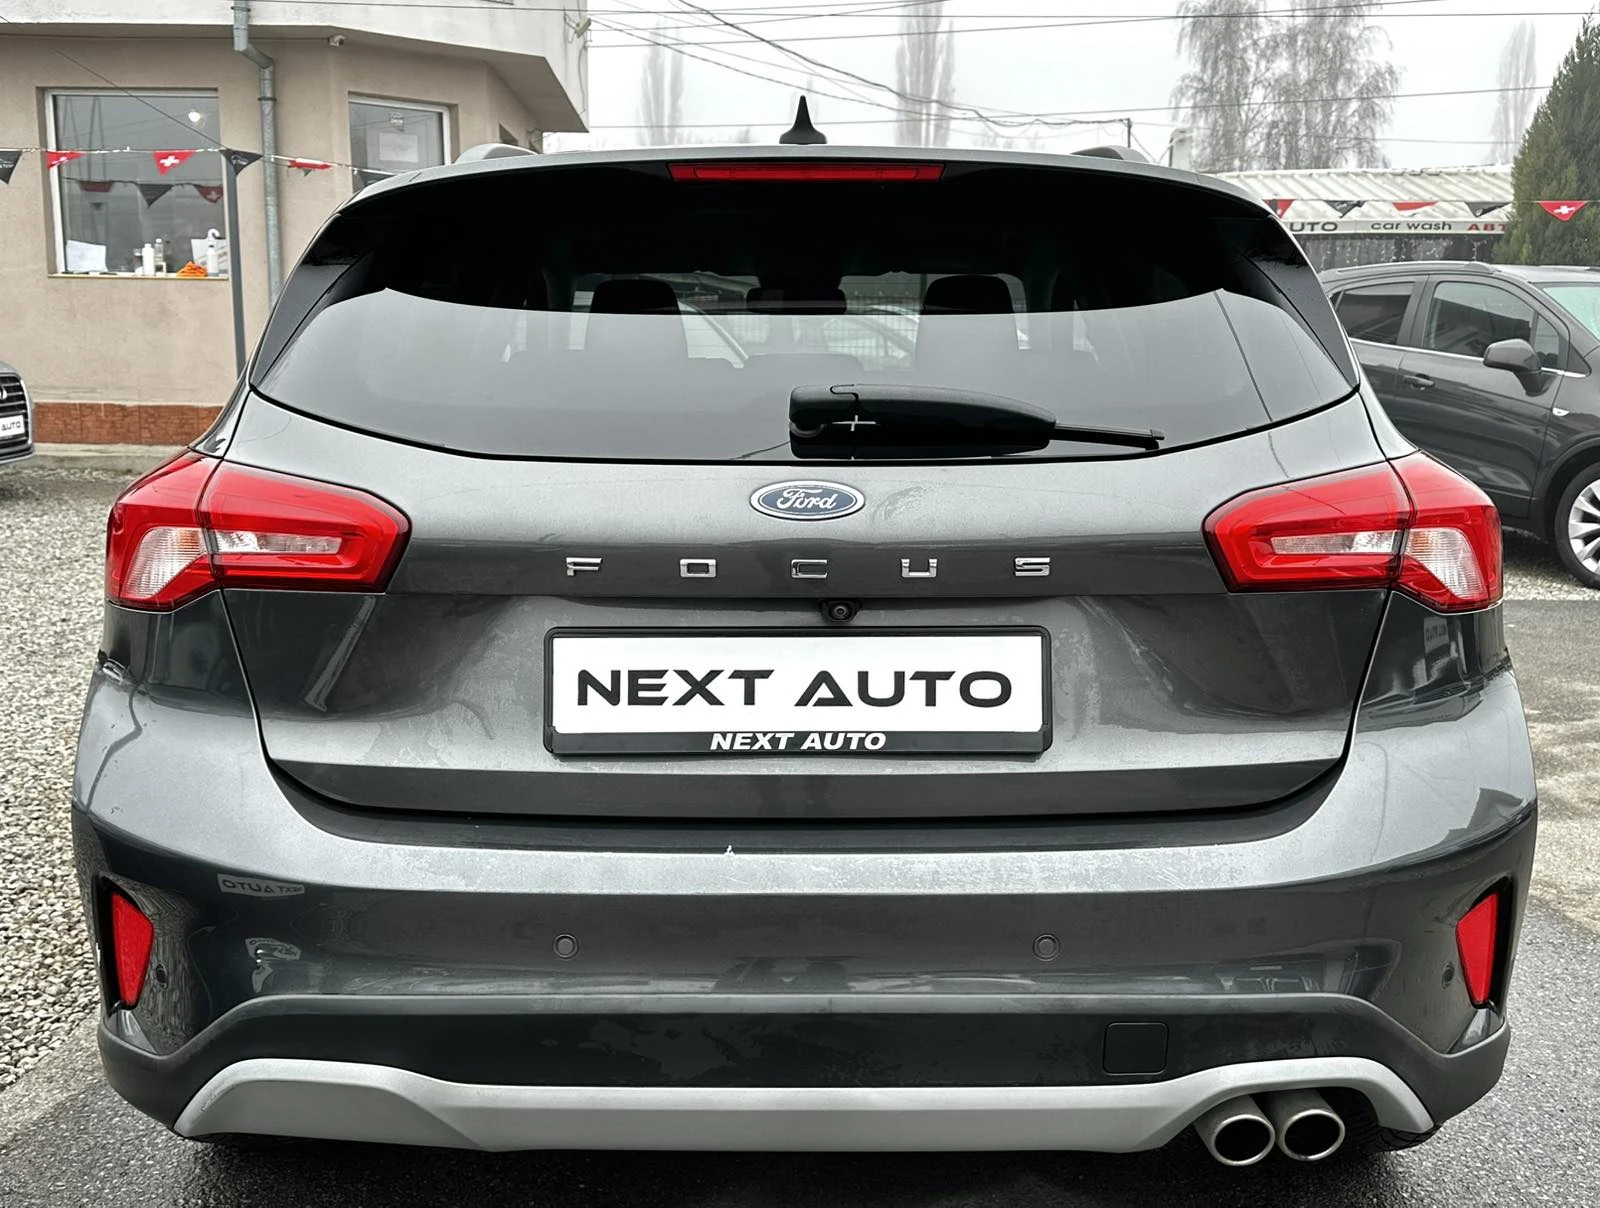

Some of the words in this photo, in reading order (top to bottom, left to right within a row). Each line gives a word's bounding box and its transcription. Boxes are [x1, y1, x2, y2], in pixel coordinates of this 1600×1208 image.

[1289, 221, 1338, 232] UTO
[1370, 222, 1400, 230] car
[1406, 221, 1452, 230] wash
[776, 488, 838, 509] Ford
[565, 557, 1051, 579] FOCUS
[578, 669, 775, 706] NEXT
[794, 670, 1012, 707] AUTO
[710, 733, 795, 750] NEXT
[799, 733, 887, 750] AUTO
